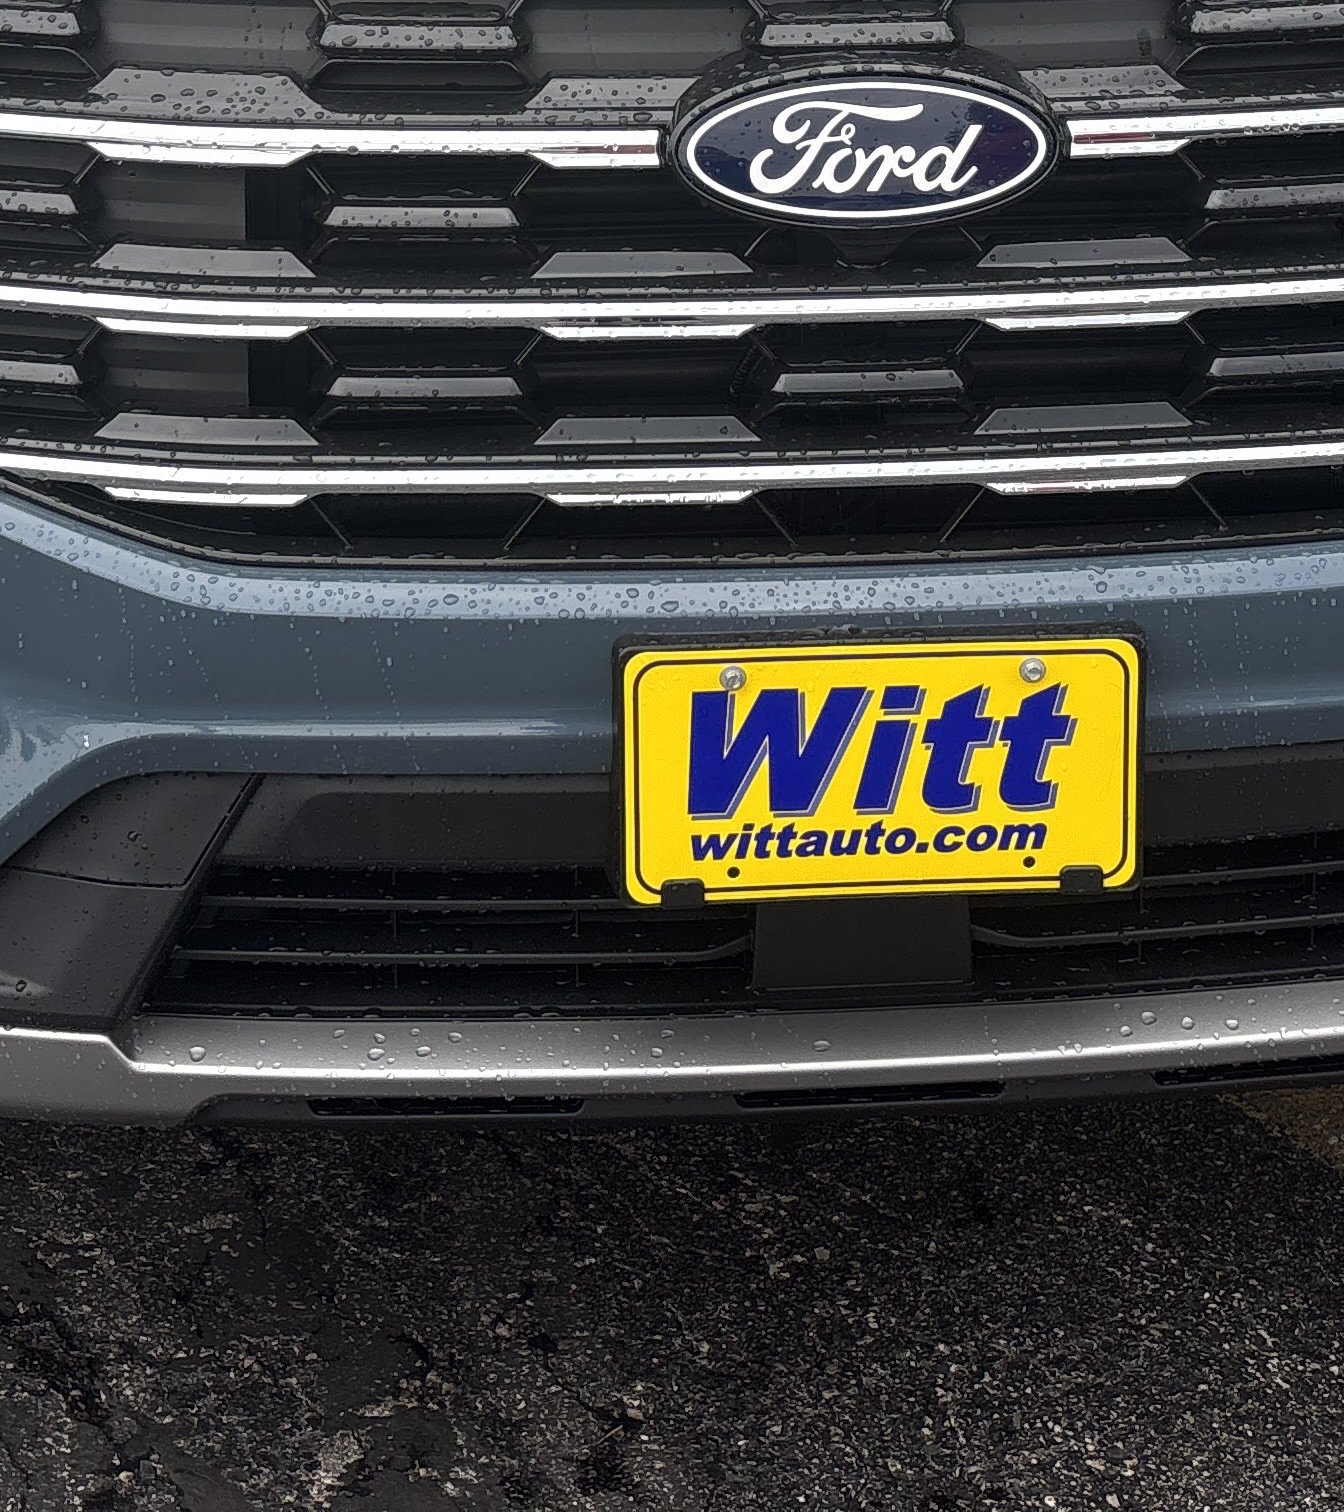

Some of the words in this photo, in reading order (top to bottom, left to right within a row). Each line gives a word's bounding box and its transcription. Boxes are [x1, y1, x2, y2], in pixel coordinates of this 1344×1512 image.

[749, 100, 983, 194] Ford
[686, 682, 1079, 820] Witt
[690, 819, 1049, 863] wittauto.com
